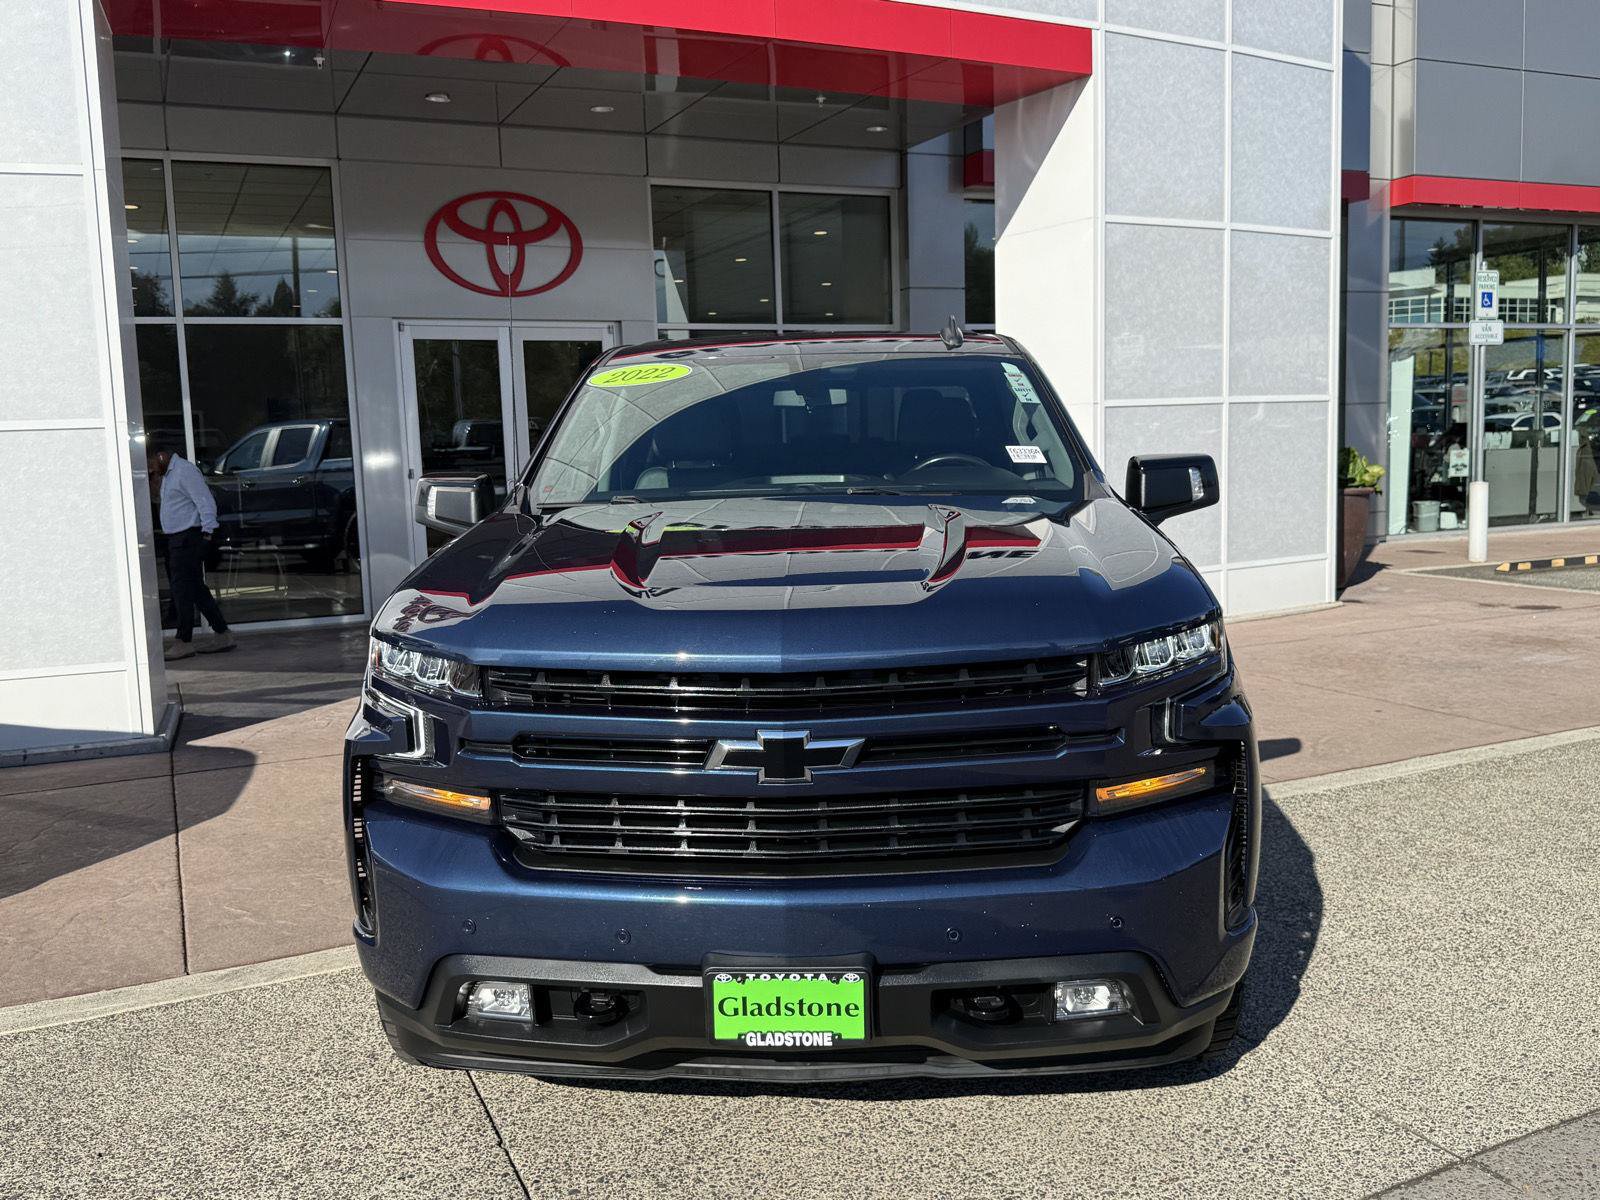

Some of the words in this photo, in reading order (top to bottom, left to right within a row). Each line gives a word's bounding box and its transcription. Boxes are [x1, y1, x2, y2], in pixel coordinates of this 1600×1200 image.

[602, 366, 676, 384] 2022
[745, 973, 829, 982] TOYOTA
[717, 996, 860, 1018] Gladstone
[745, 1031, 833, 1047] GLADSTONE
